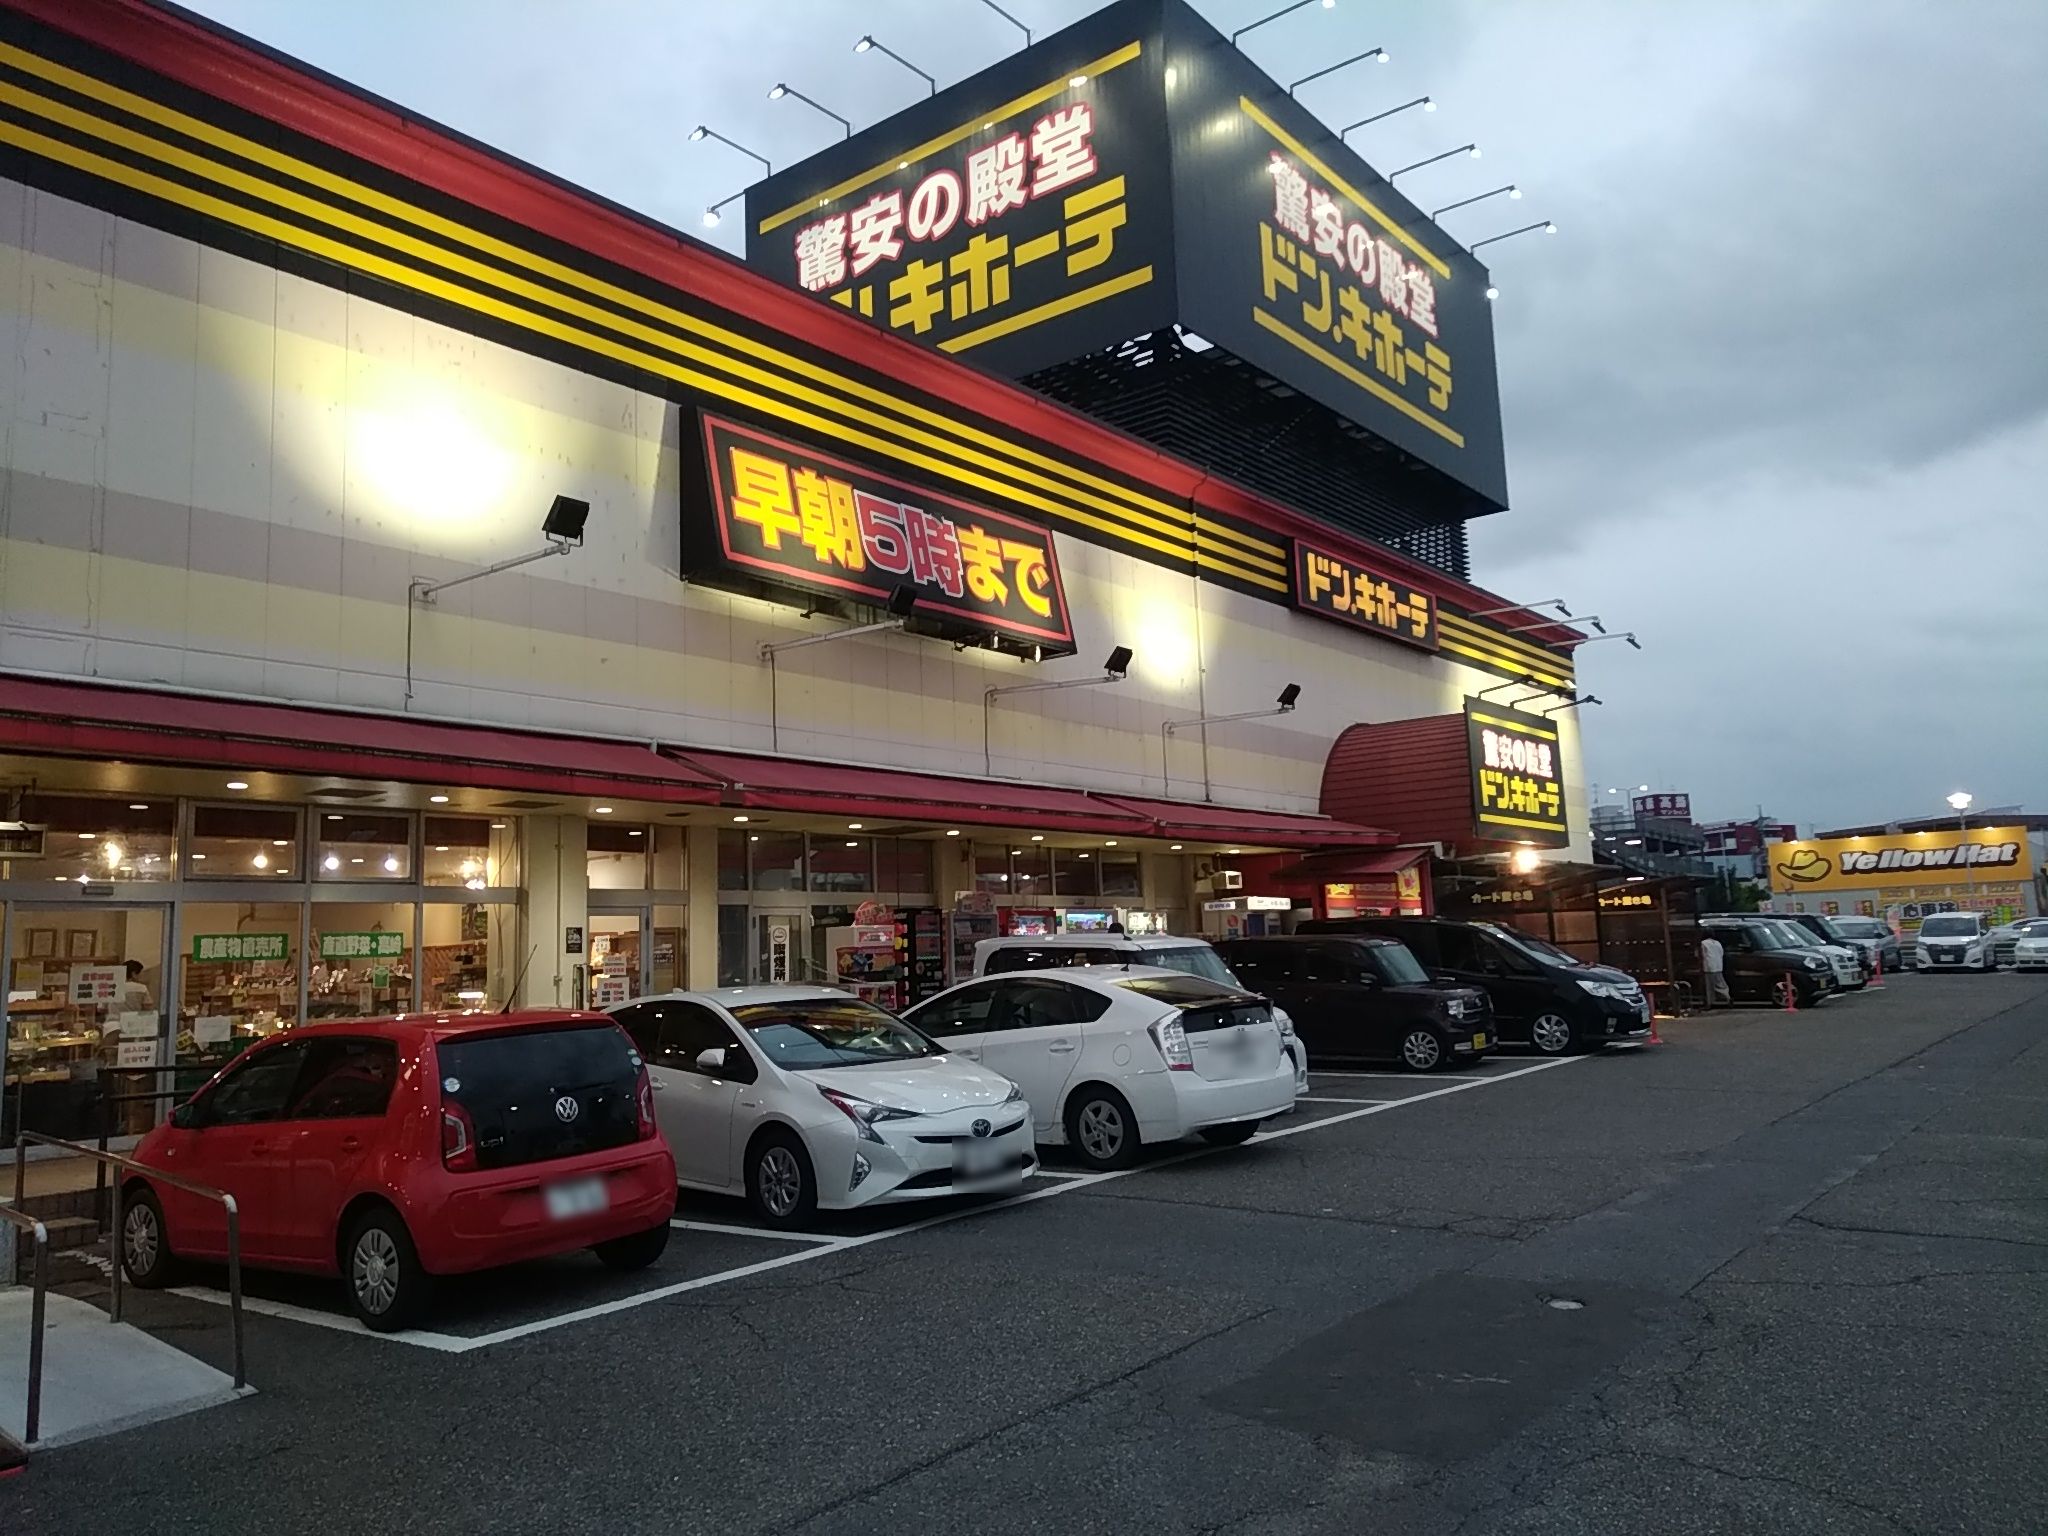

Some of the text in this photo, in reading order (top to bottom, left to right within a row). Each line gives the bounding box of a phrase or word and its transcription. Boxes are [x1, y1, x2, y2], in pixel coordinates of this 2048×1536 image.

[795, 102, 1098, 292] 驚安の殿堂
[1268, 151, 1439, 339] 驚安の殿堂
[730, 446, 1052, 618] 早朝5時まで
